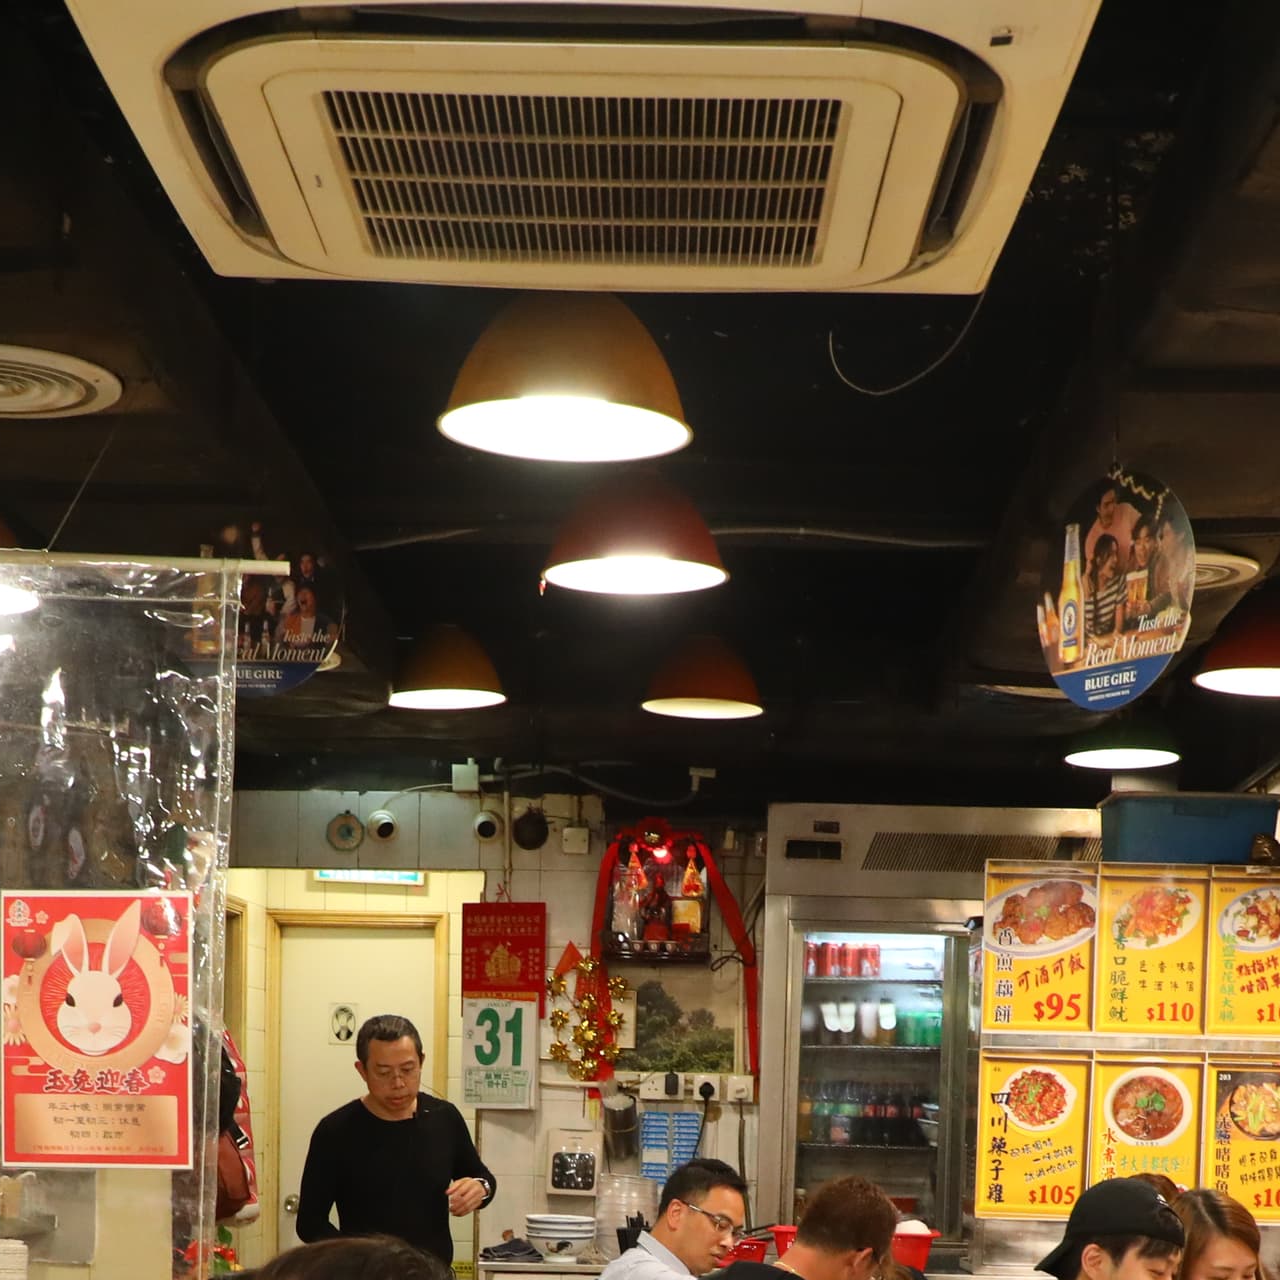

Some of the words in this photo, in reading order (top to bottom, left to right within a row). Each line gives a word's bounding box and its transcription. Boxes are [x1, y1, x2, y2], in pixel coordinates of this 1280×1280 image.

[1137, 614, 1161, 633] Taste
[1163, 613, 1180, 628] the
[312, 628, 330, 642] the
[266, 642, 325, 660] Moment
[1084, 642, 1119, 668] Real
[1121, 632, 1177, 659] Moment
[254, 669, 283, 679] GIRL
[1084, 675, 1110, 691] BLUE
[1111, 670, 1137, 686] GIRL
[1018, 953, 1085, 992] 可酒可飯
[1034, 993, 1081, 1021] $95
[1147, 1002, 1194, 1021] $110
[474, 1007, 523, 1066] 31
[43, 1068, 150, 1094] 玉兔迎春
[1028, 1185, 1075, 1204] $105
